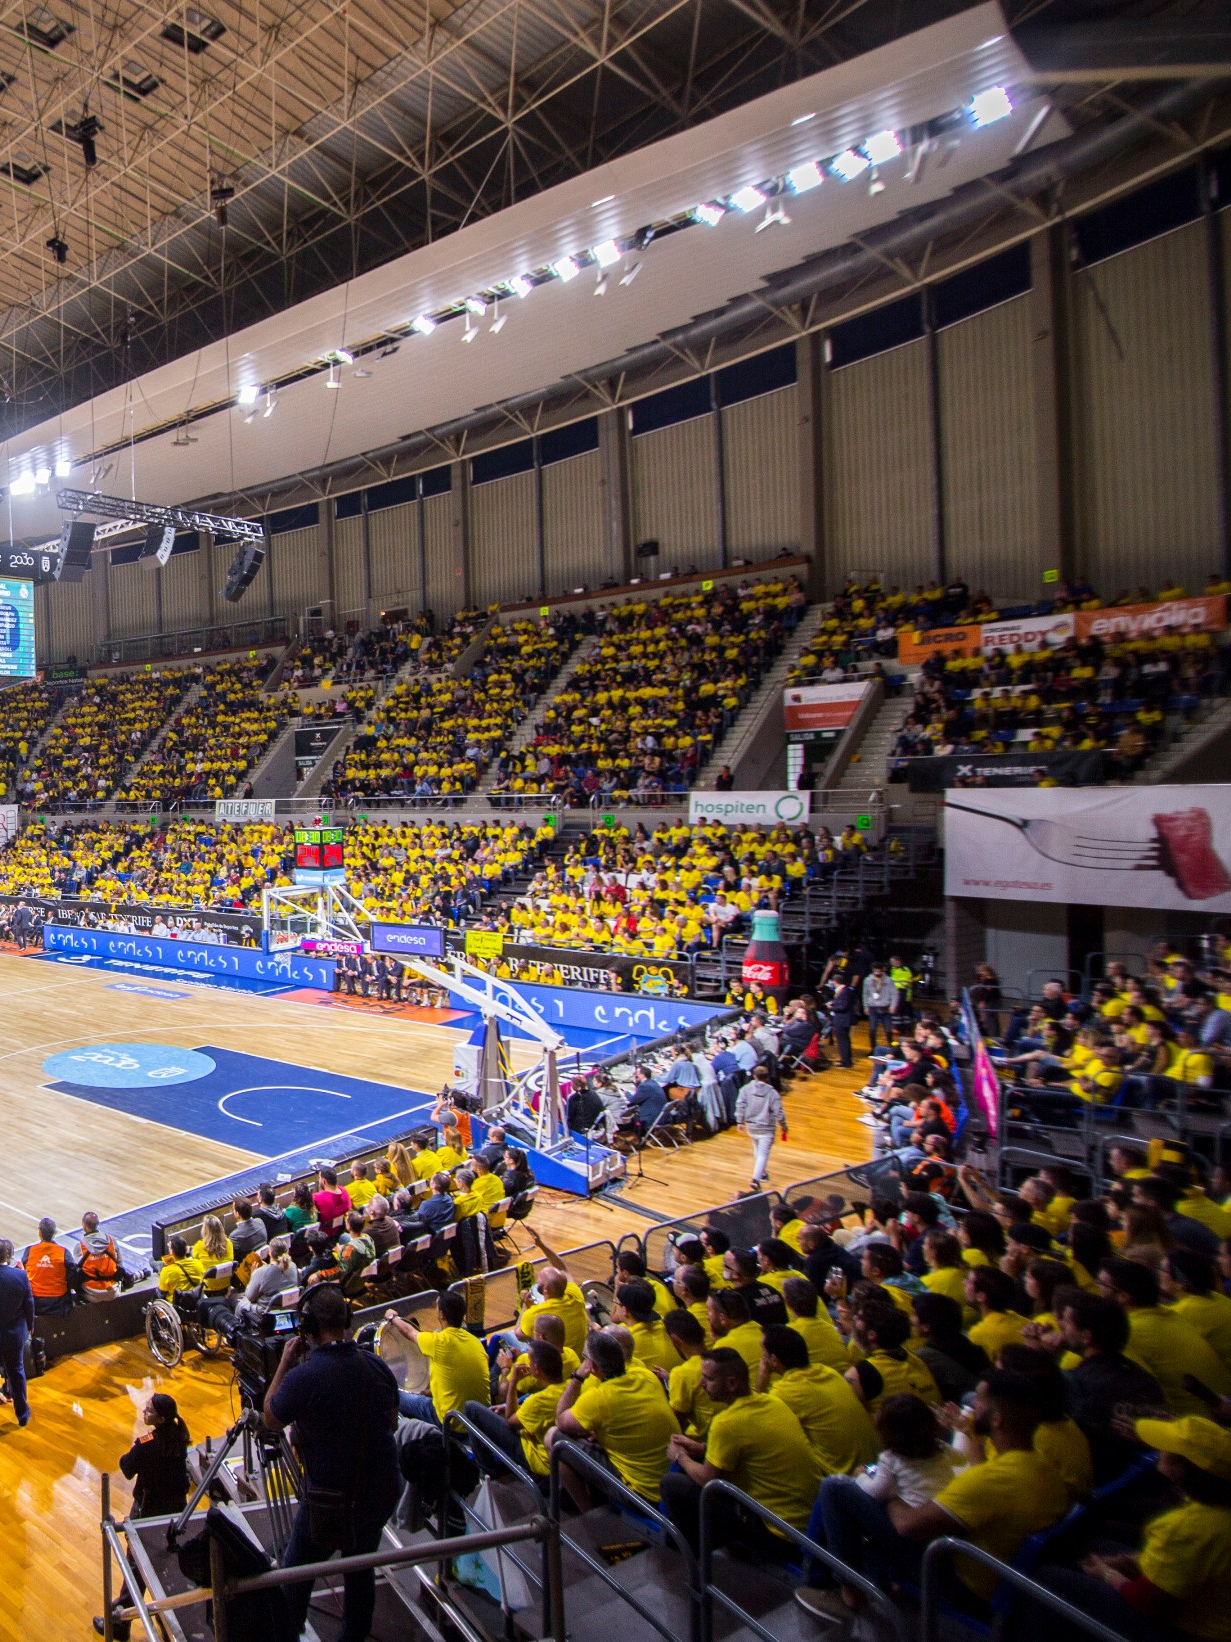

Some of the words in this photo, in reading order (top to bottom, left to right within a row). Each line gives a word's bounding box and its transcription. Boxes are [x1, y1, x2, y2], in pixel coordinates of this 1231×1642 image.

[9, 553, 34, 567] 2030
[219, 802, 273, 814] ATEFUER
[694, 799, 767, 817] hospiten
[296, 830, 321, 843] 08:30
[297, 845, 320, 867] 24
[176, 916, 198, 927] DXT
[387, 933, 426, 946] endesa
[316, 942, 357, 954] endesa
